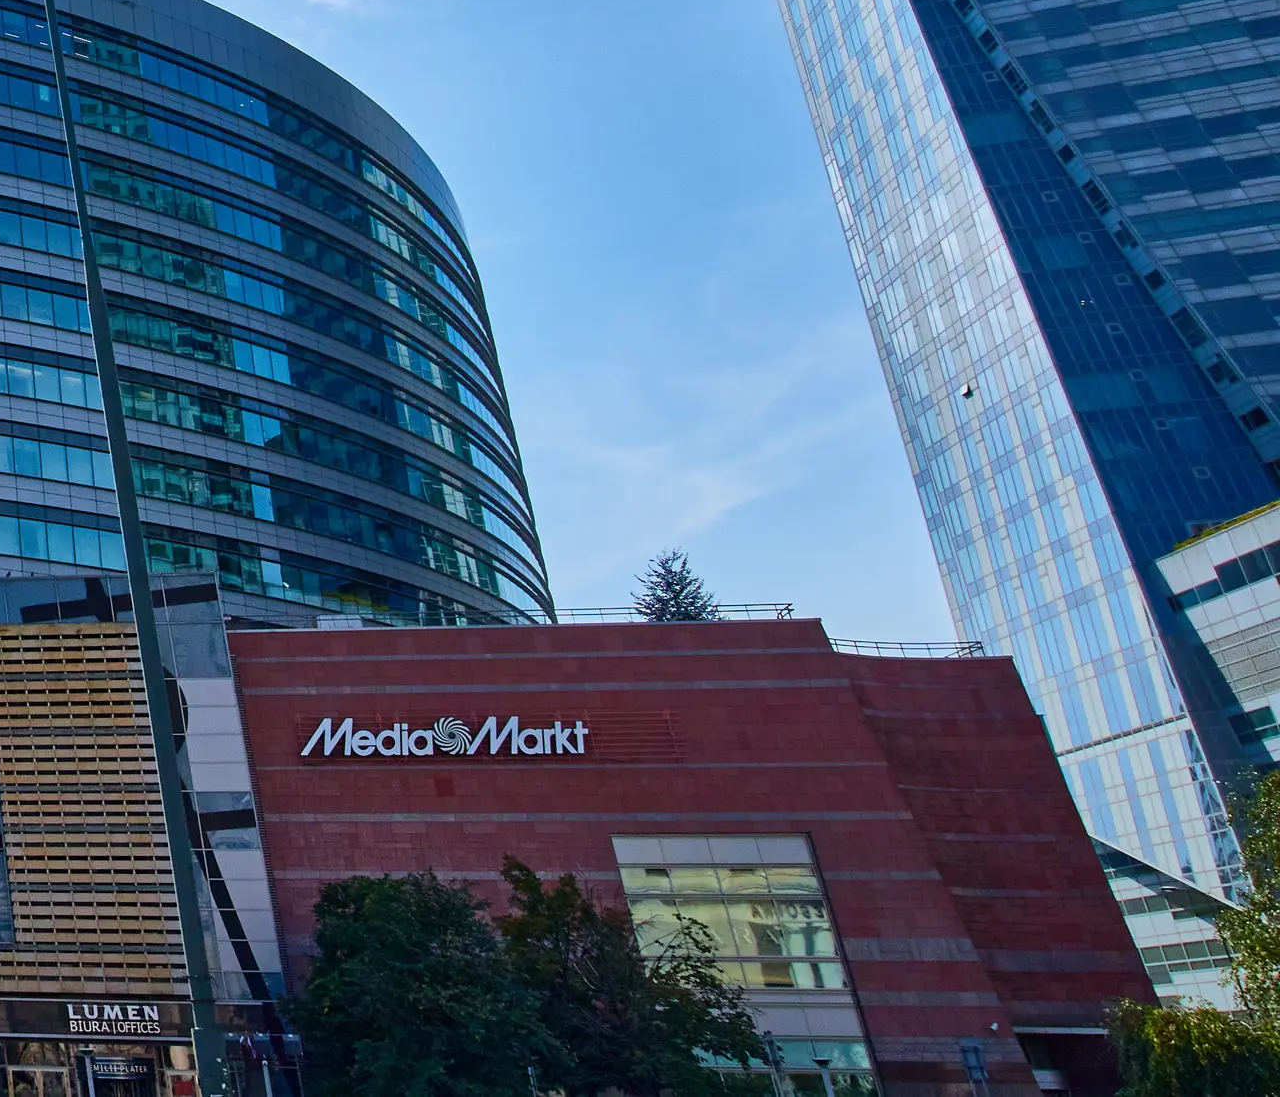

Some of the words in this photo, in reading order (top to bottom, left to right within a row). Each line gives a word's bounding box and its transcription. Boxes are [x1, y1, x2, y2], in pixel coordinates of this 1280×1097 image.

[67, 1004, 159, 1020] LUMEN
[70, 1020, 110, 1033] BIURA
[117, 1021, 160, 1034] OFFICES
